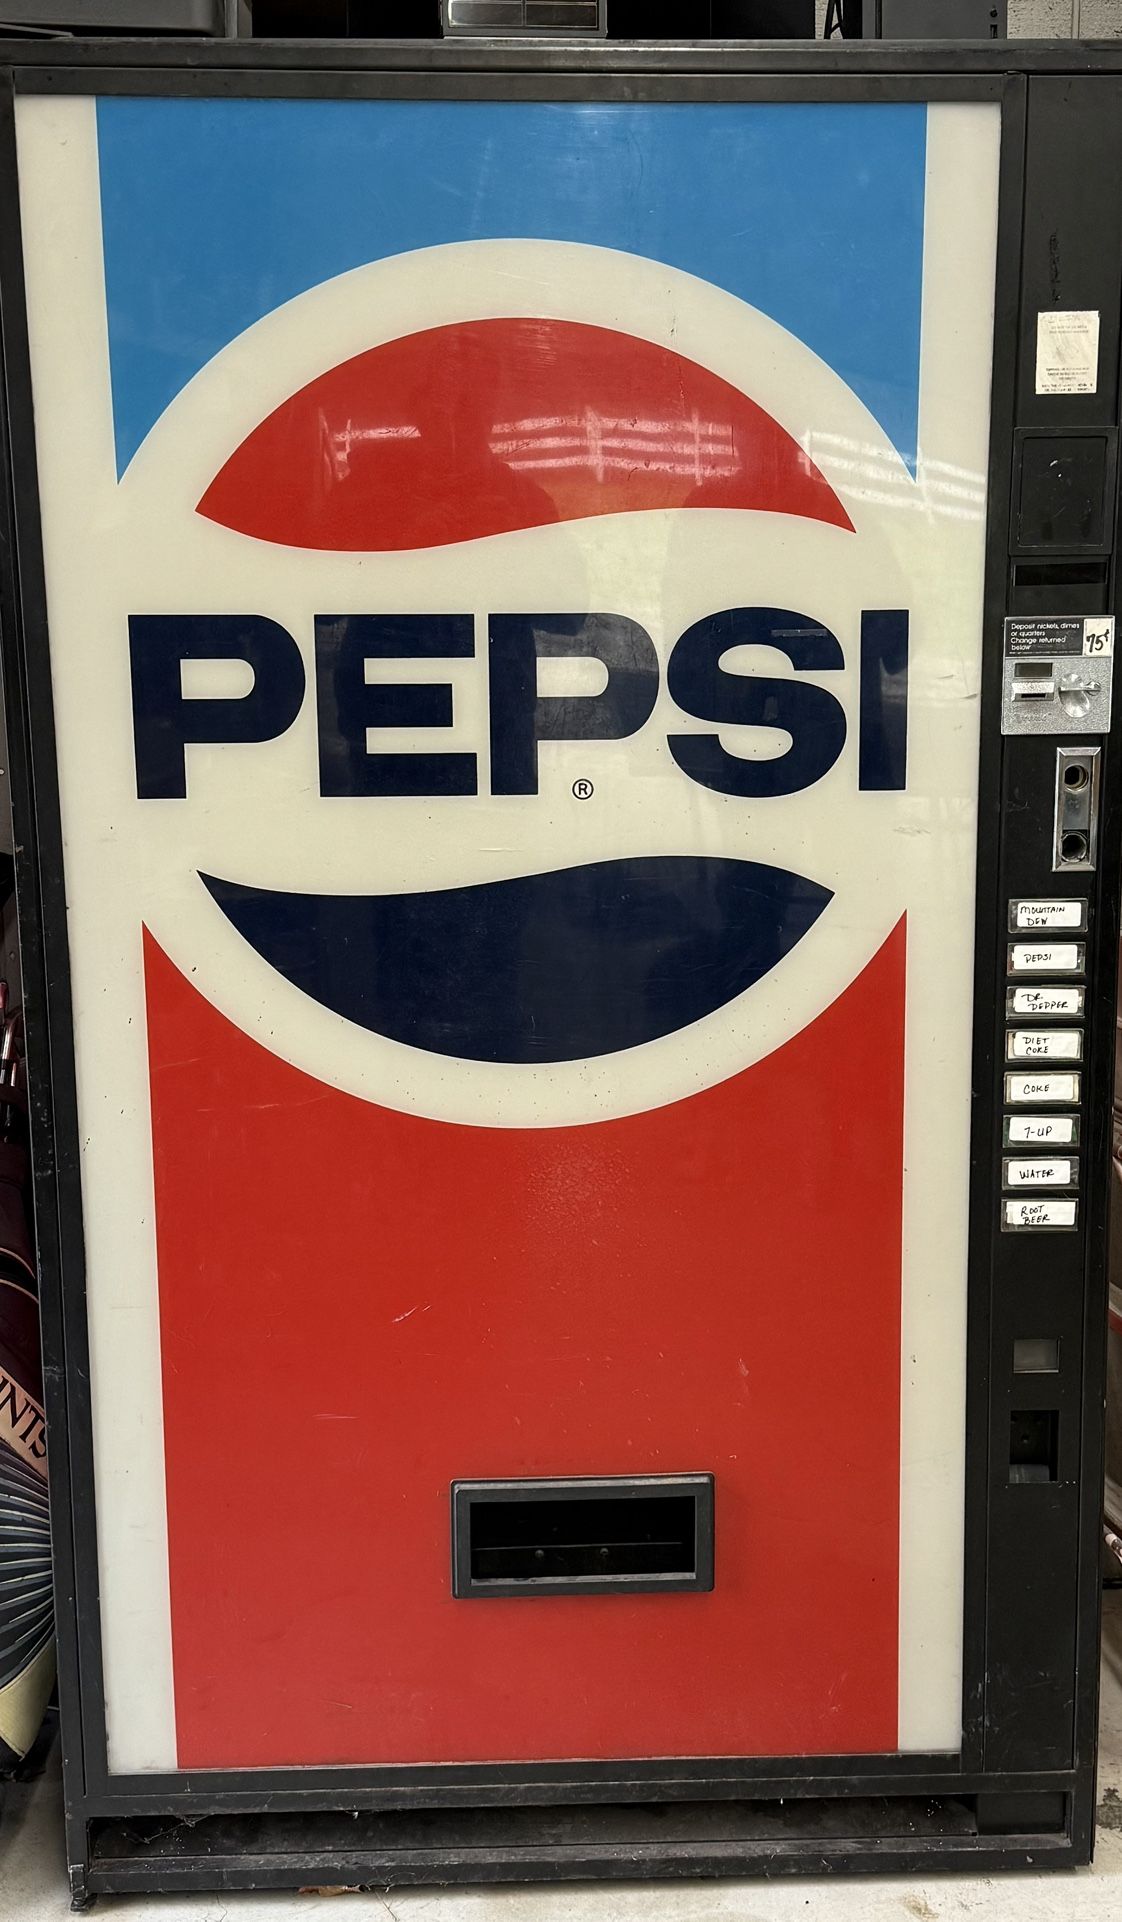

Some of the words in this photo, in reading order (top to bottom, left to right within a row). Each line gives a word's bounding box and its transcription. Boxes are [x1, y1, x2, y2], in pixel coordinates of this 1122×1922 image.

[1011, 622, 1036, 631] Deposit
[1036, 622, 1060, 630] nickels,
[1019, 630, 1046, 638] quarters
[1010, 637, 1037, 645] Change
[1038, 636, 1067, 644] returned
[128, 607, 910, 799] PEPSI
[1020, 905, 1066, 915] MOUNTAIN
[1026, 917, 1048, 926] DEW
[1023, 953, 1052, 964] PEPSI
[1028, 1001, 1069, 1011] PEPPER
[1022, 1036, 1050, 1045] DIET
[1025, 1046, 1049, 1056] COKE
[1023, 1084, 1050, 1095] COKE
[1024, 1126, 1053, 1139] 7-UP
[1019, 1168, 1055, 1180] WATER
[1020, 1205, 1045, 1216] ROOT
[1022, 1213, 1050, 1226] BEER
